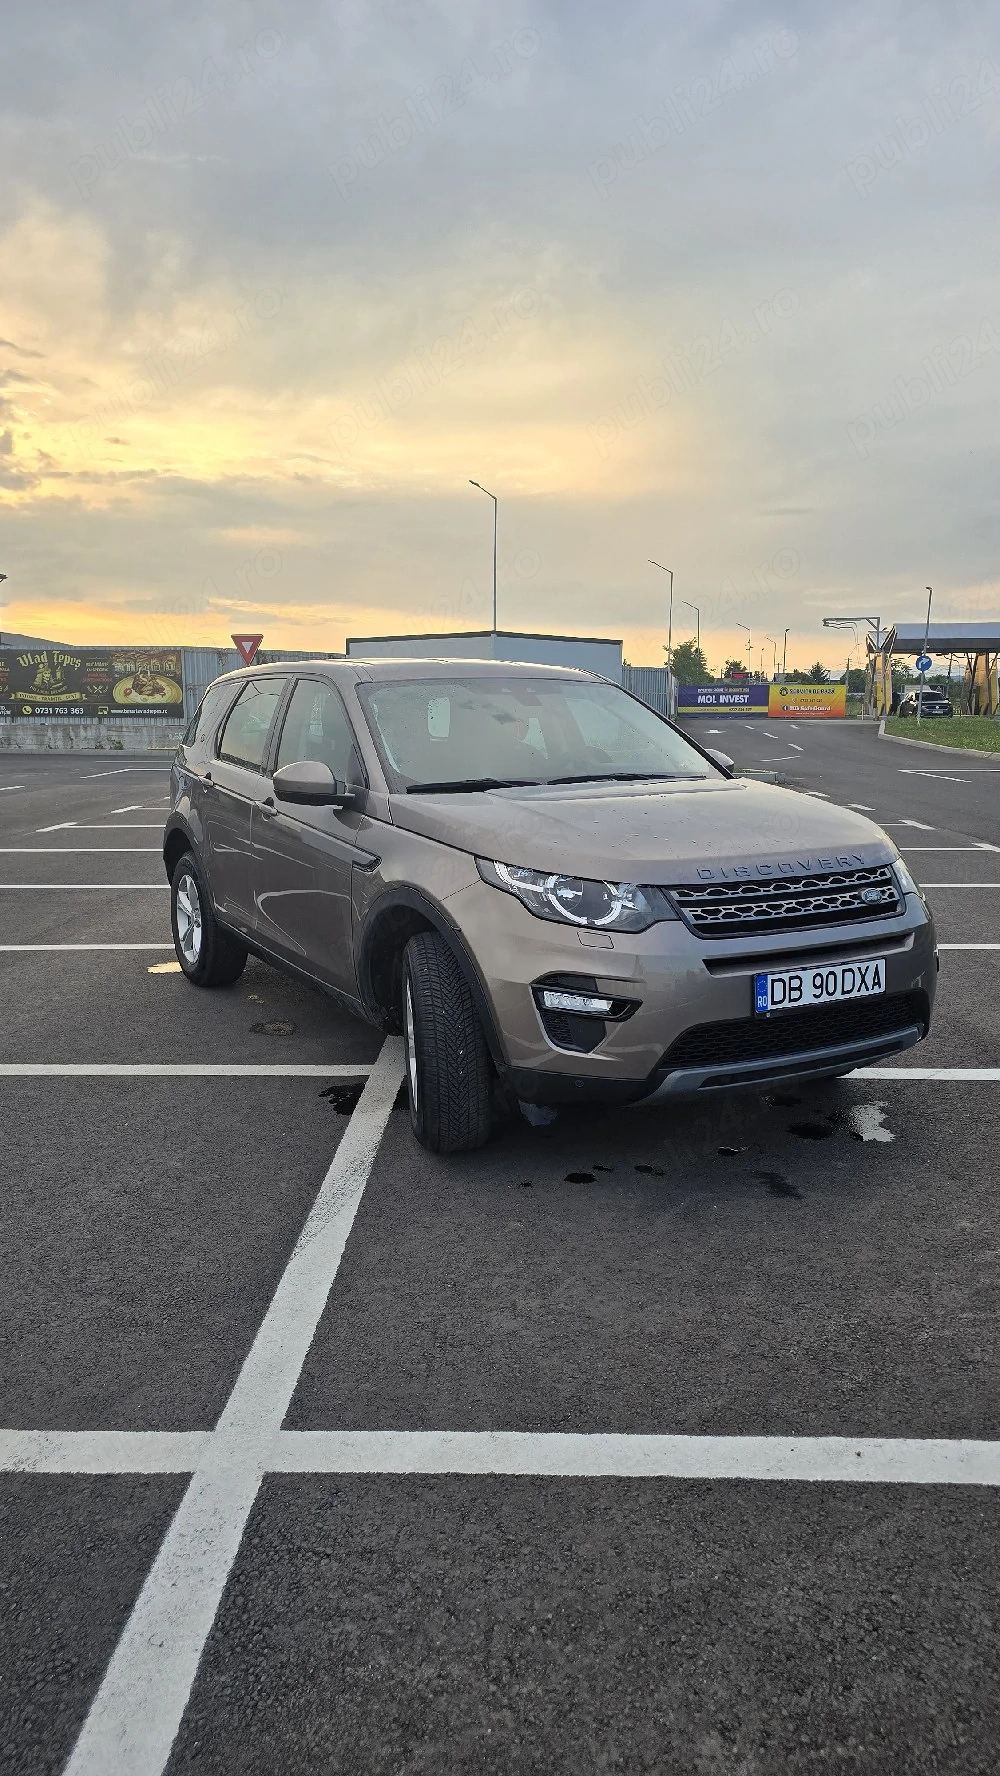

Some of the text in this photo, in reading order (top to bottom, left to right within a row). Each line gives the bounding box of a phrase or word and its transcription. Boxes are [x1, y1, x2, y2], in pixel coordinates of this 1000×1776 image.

[16, 651, 48, 667] Vlad
[697, 694, 750, 704] MOL INVEST
[696, 853, 867, 880] DISCOVERY
[770, 974, 803, 1006] DB
[757, 995, 767, 1007] RO
